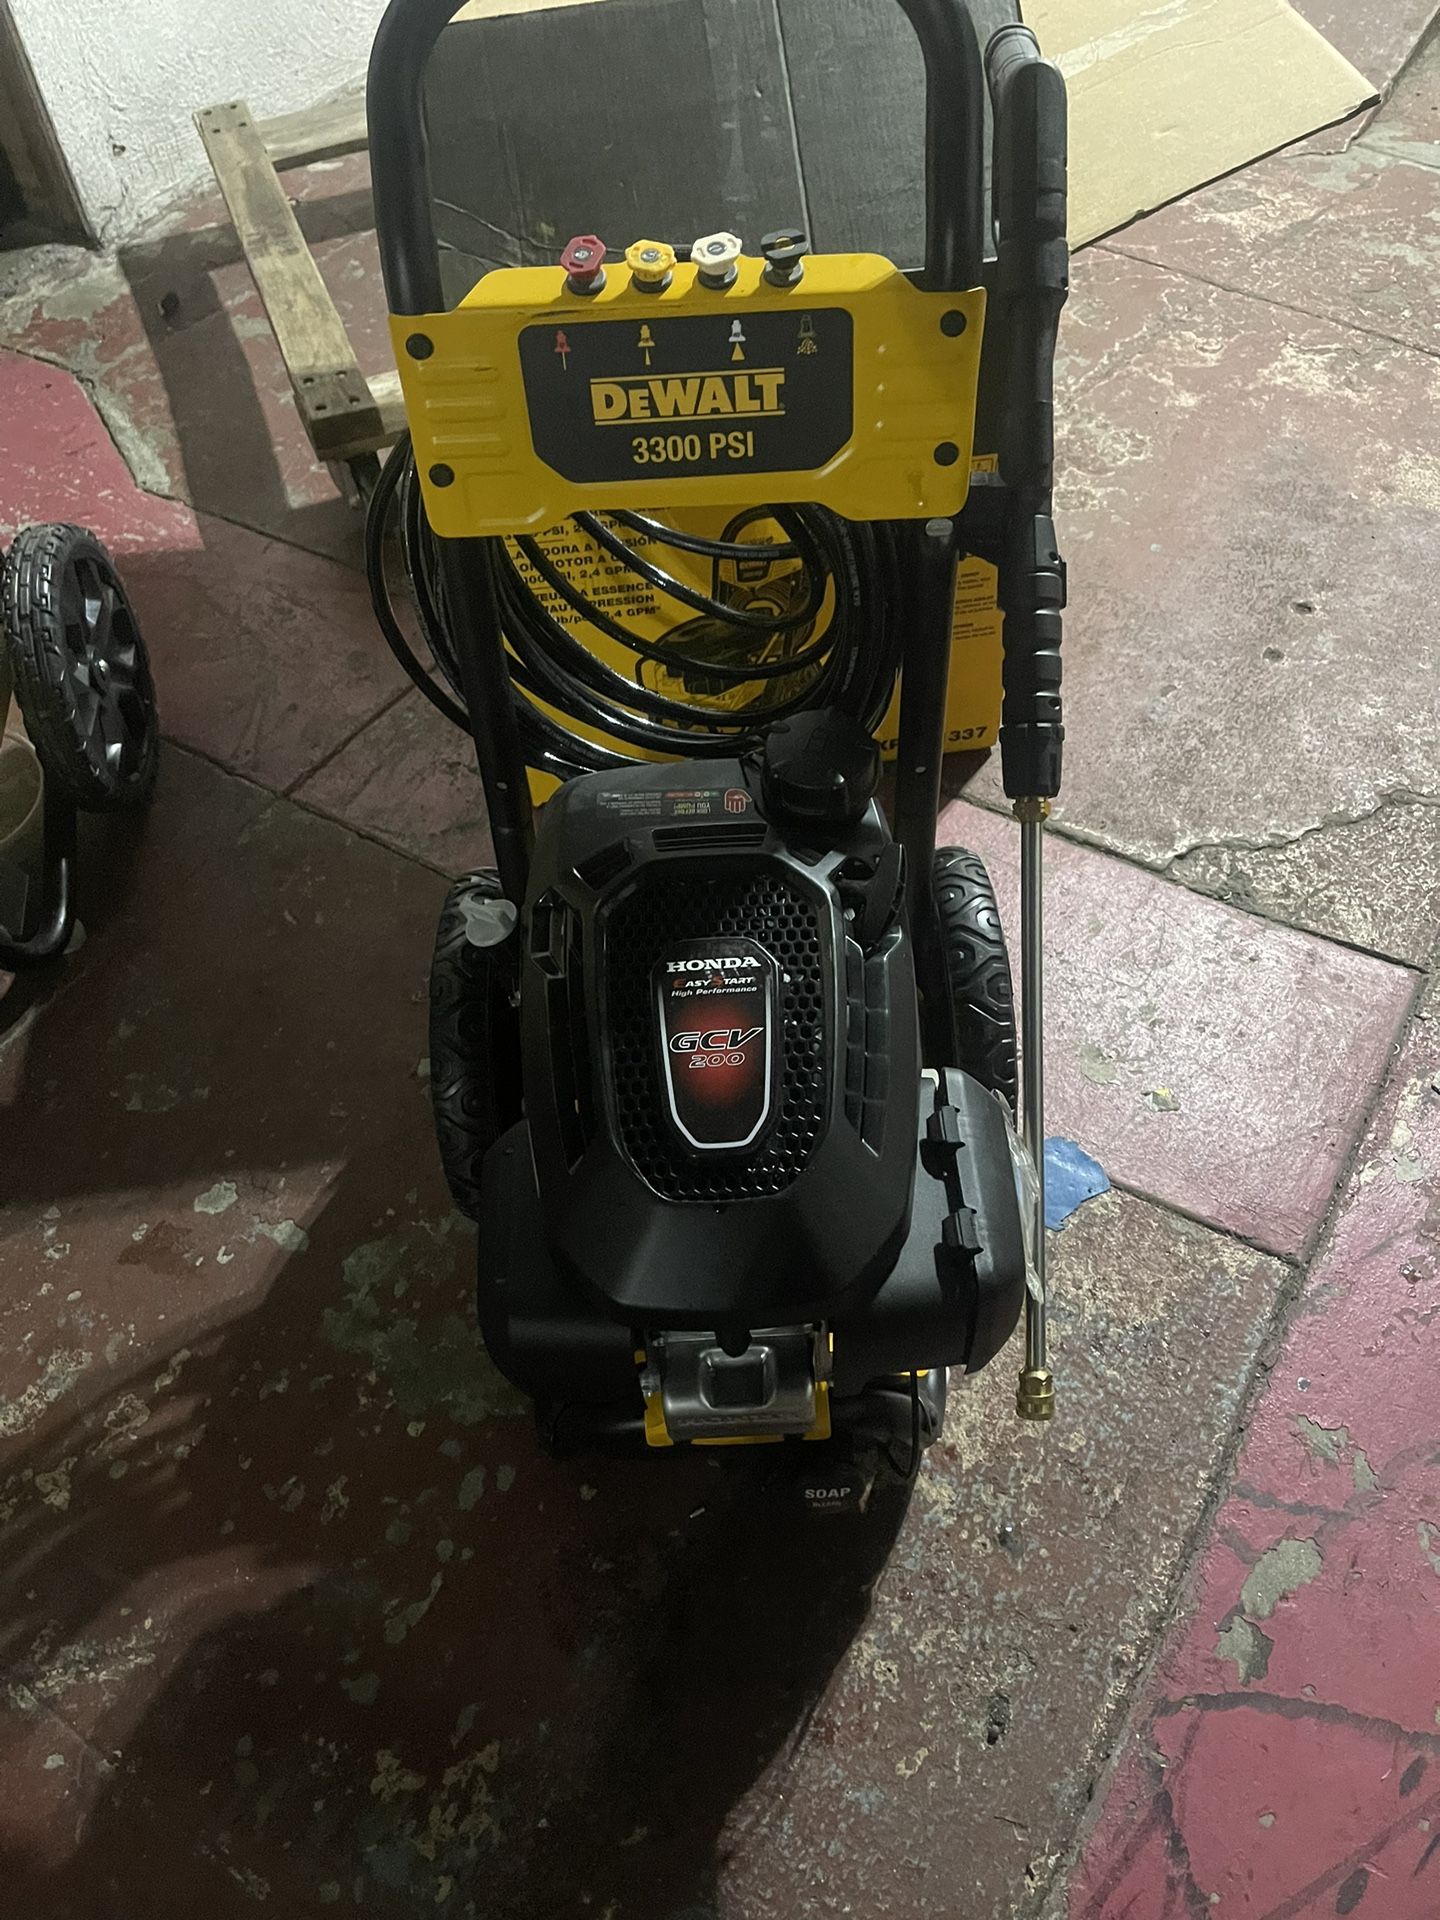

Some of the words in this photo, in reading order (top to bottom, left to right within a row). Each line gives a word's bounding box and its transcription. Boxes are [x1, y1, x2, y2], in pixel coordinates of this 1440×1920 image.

[631, 434, 701, 464] 3300
[709, 431, 755, 460] PSI
[598, 554, 606, 563] A
[592, 582, 654, 596] ESSENCE
[948, 726, 988, 742] 337
[665, 956, 762, 974] HONDA
[671, 989, 693, 998] High
[695, 986, 758, 996] Performance
[669, 1026, 765, 1054] GCV
[688, 1052, 746, 1069] 200
[804, 1487, 852, 1499] SOAP
